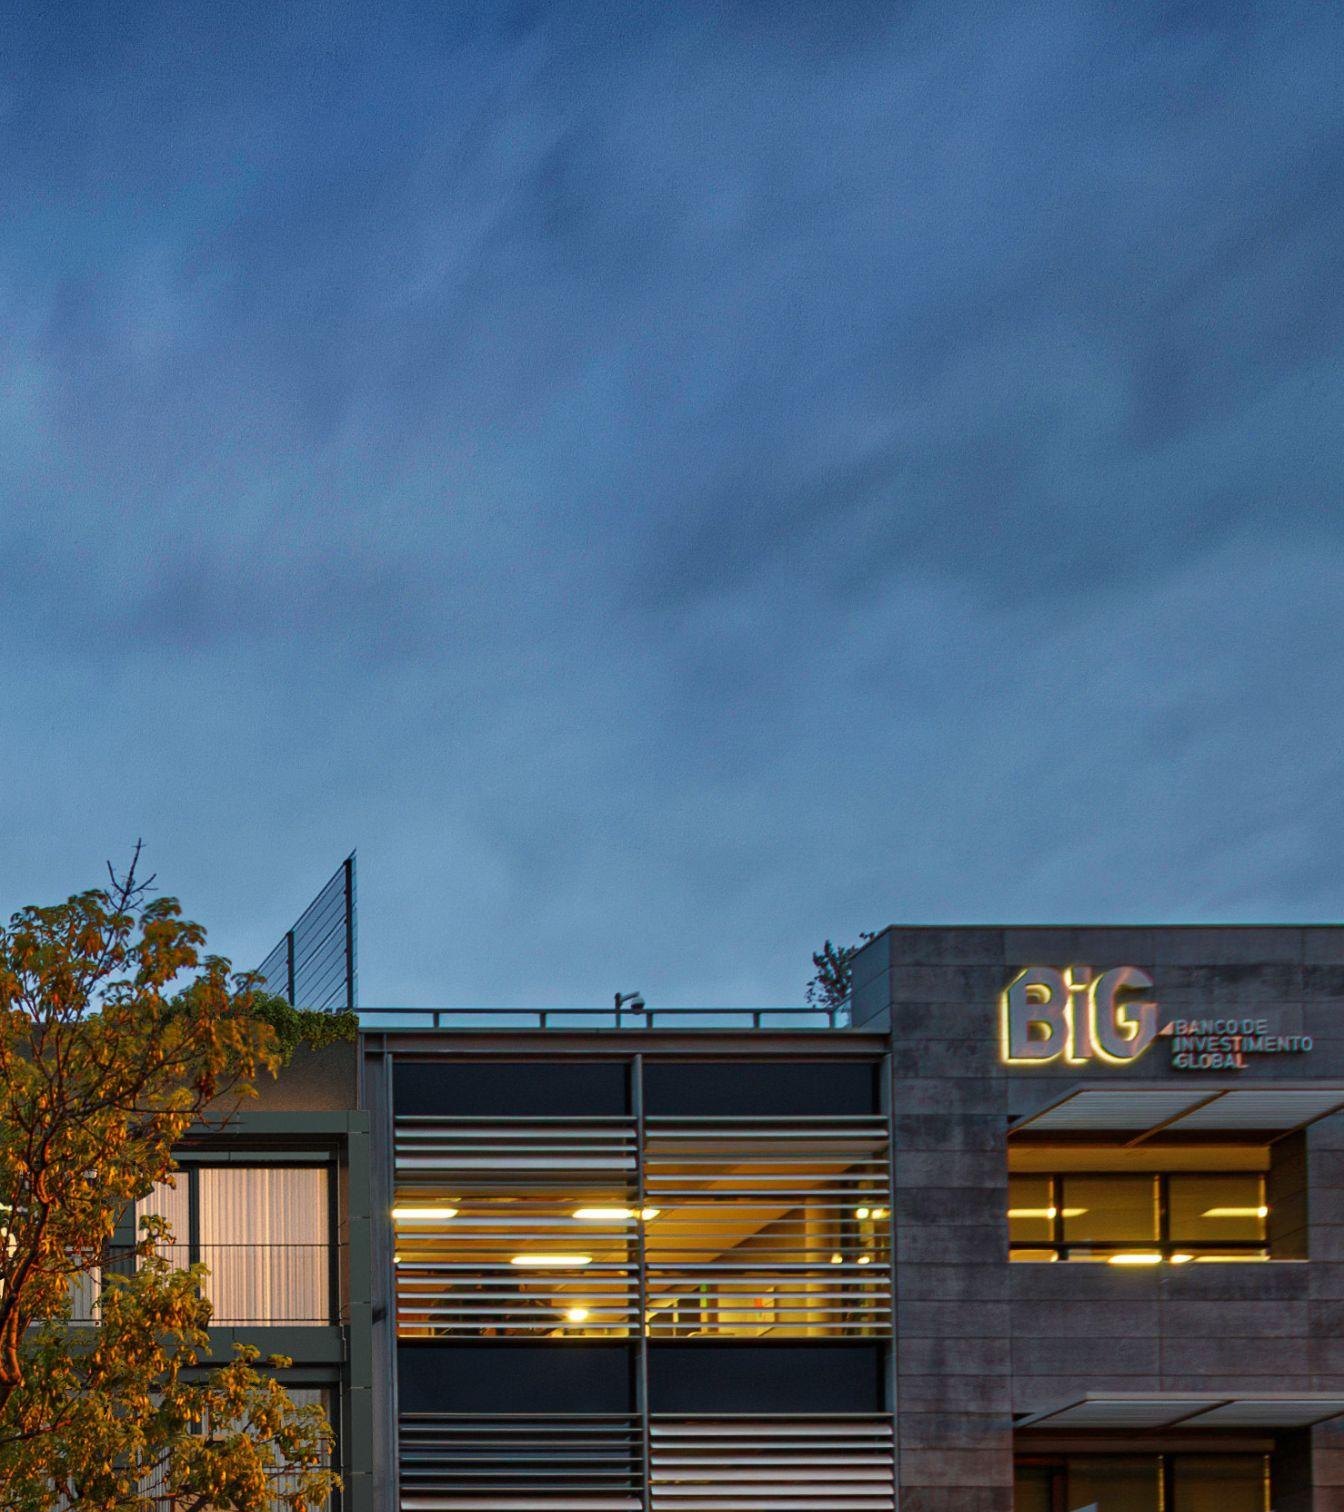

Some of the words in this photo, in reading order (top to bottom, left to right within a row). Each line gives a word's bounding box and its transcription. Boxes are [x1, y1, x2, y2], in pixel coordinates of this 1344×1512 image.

[1175, 1019, 1239, 1035] BANCO
[1242, 1019, 1269, 1035] DE
[1174, 1036, 1313, 1052] INVESTIMENTO
[1175, 1053, 1250, 1069] GLOBAL
